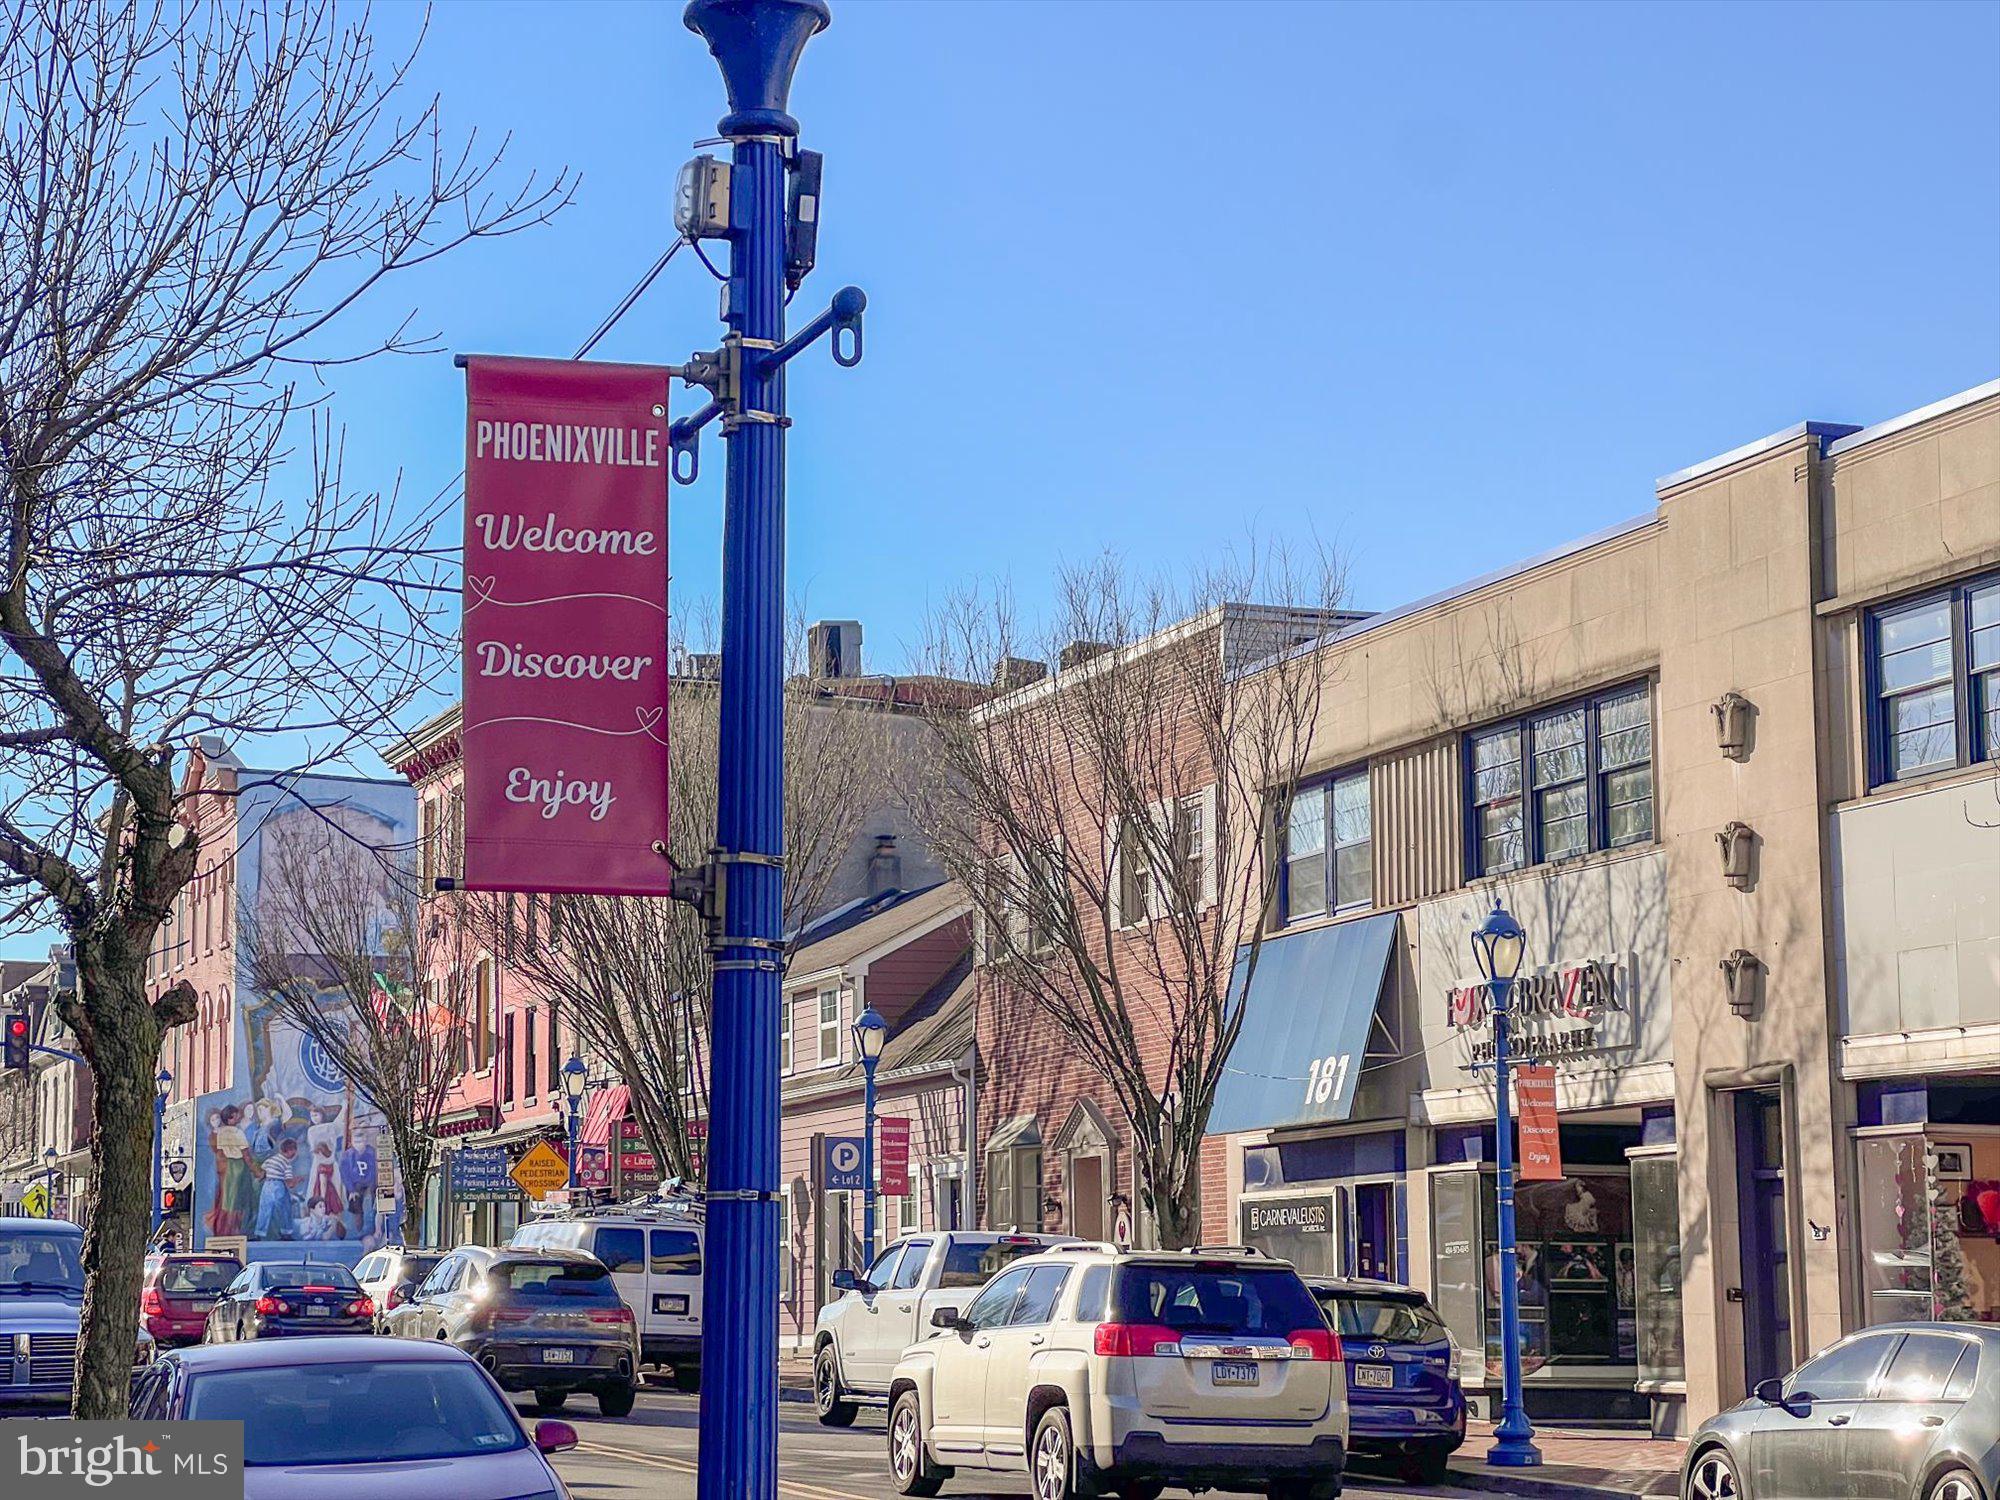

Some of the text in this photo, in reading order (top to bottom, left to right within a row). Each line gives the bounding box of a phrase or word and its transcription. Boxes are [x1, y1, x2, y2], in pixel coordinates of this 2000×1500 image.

[476, 420, 660, 468] PHOENIXVILLE
[475, 512, 657, 555] Welcome
[476, 641, 653, 681] Discover
[505, 767, 616, 820] Enjoy
[1305, 1054, 1350, 1104] 181
[1521, 1098, 1555, 1107] Welcome
[1522, 1125, 1556, 1134] Discover
[1528, 1152, 1551, 1163] Enjoy
[356, 1161, 368, 1176] P
[463, 1166, 486, 1174] Parking
[520, 1169, 565, 1177] PEDESTRIAN
[463, 1180, 486, 1188] Parking
[524, 1179, 561, 1188] CROSSING
[842, 1175, 860, 1184] Lot 2
